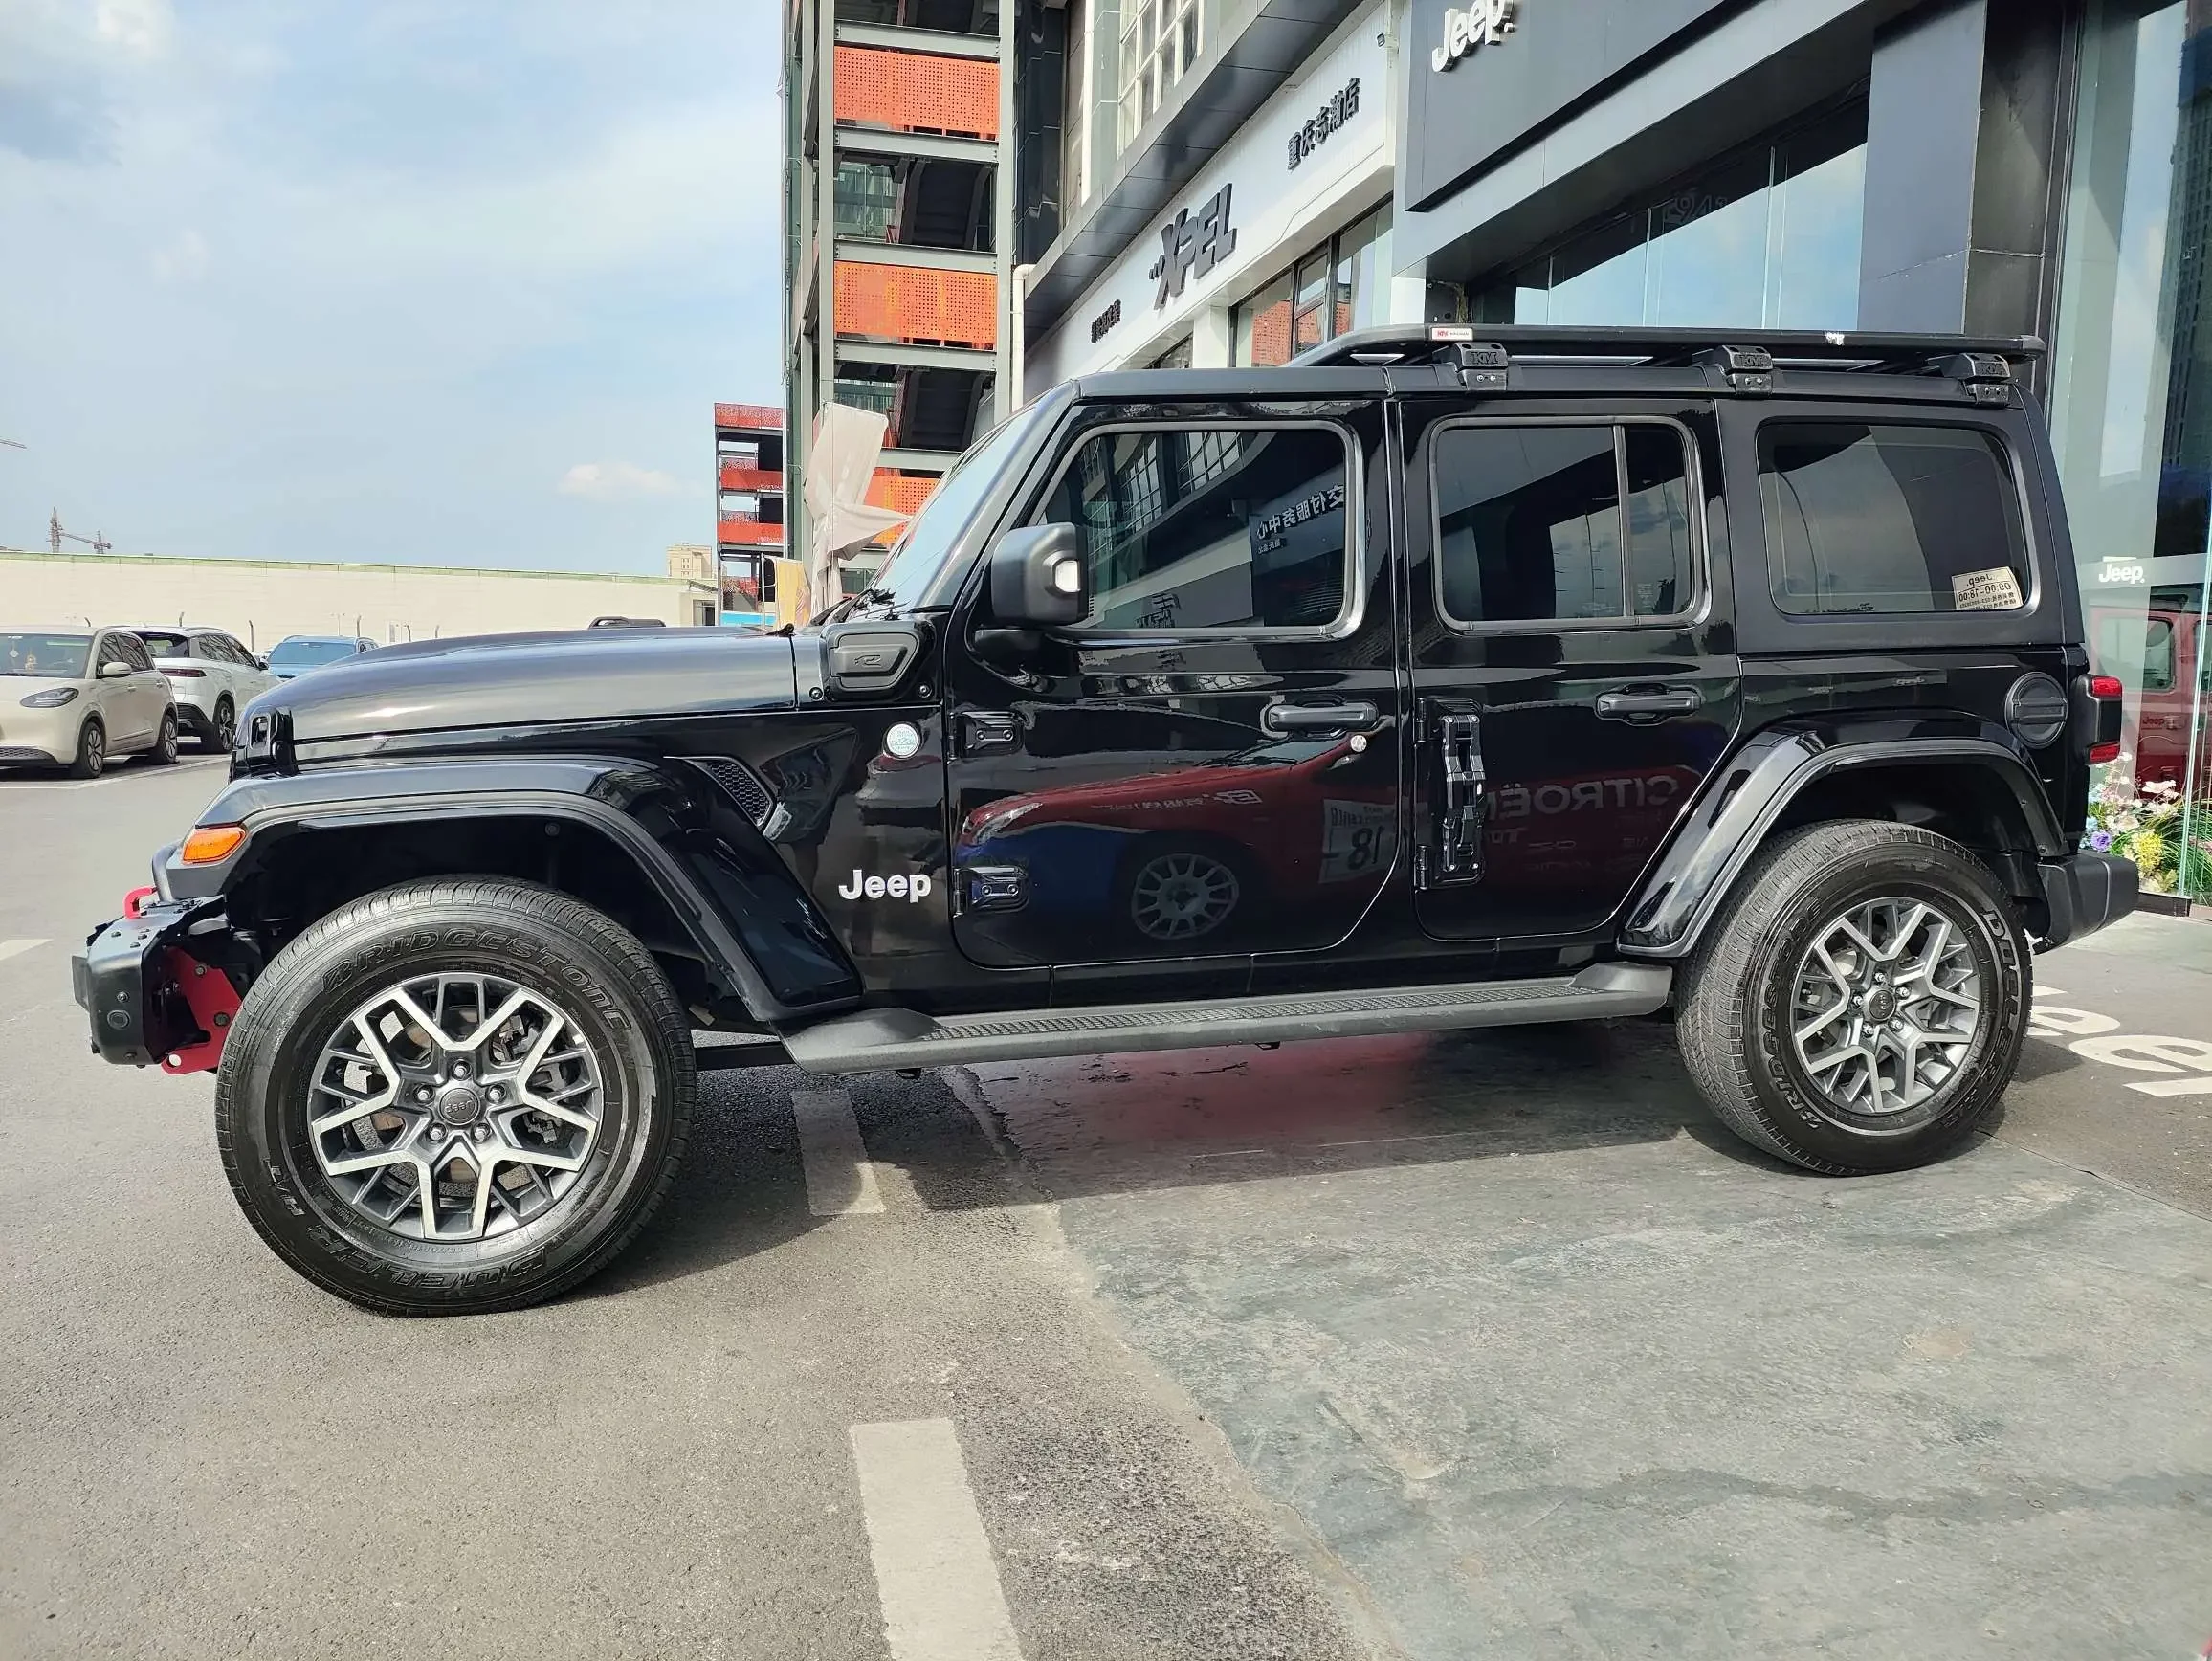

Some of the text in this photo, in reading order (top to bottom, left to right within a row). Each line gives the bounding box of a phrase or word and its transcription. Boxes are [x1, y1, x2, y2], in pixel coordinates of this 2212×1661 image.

[1153, 183, 1237, 310] XPEL
[838, 869, 932, 904] Jeep
[321, 926, 633, 1031] BRIDGESTONE
